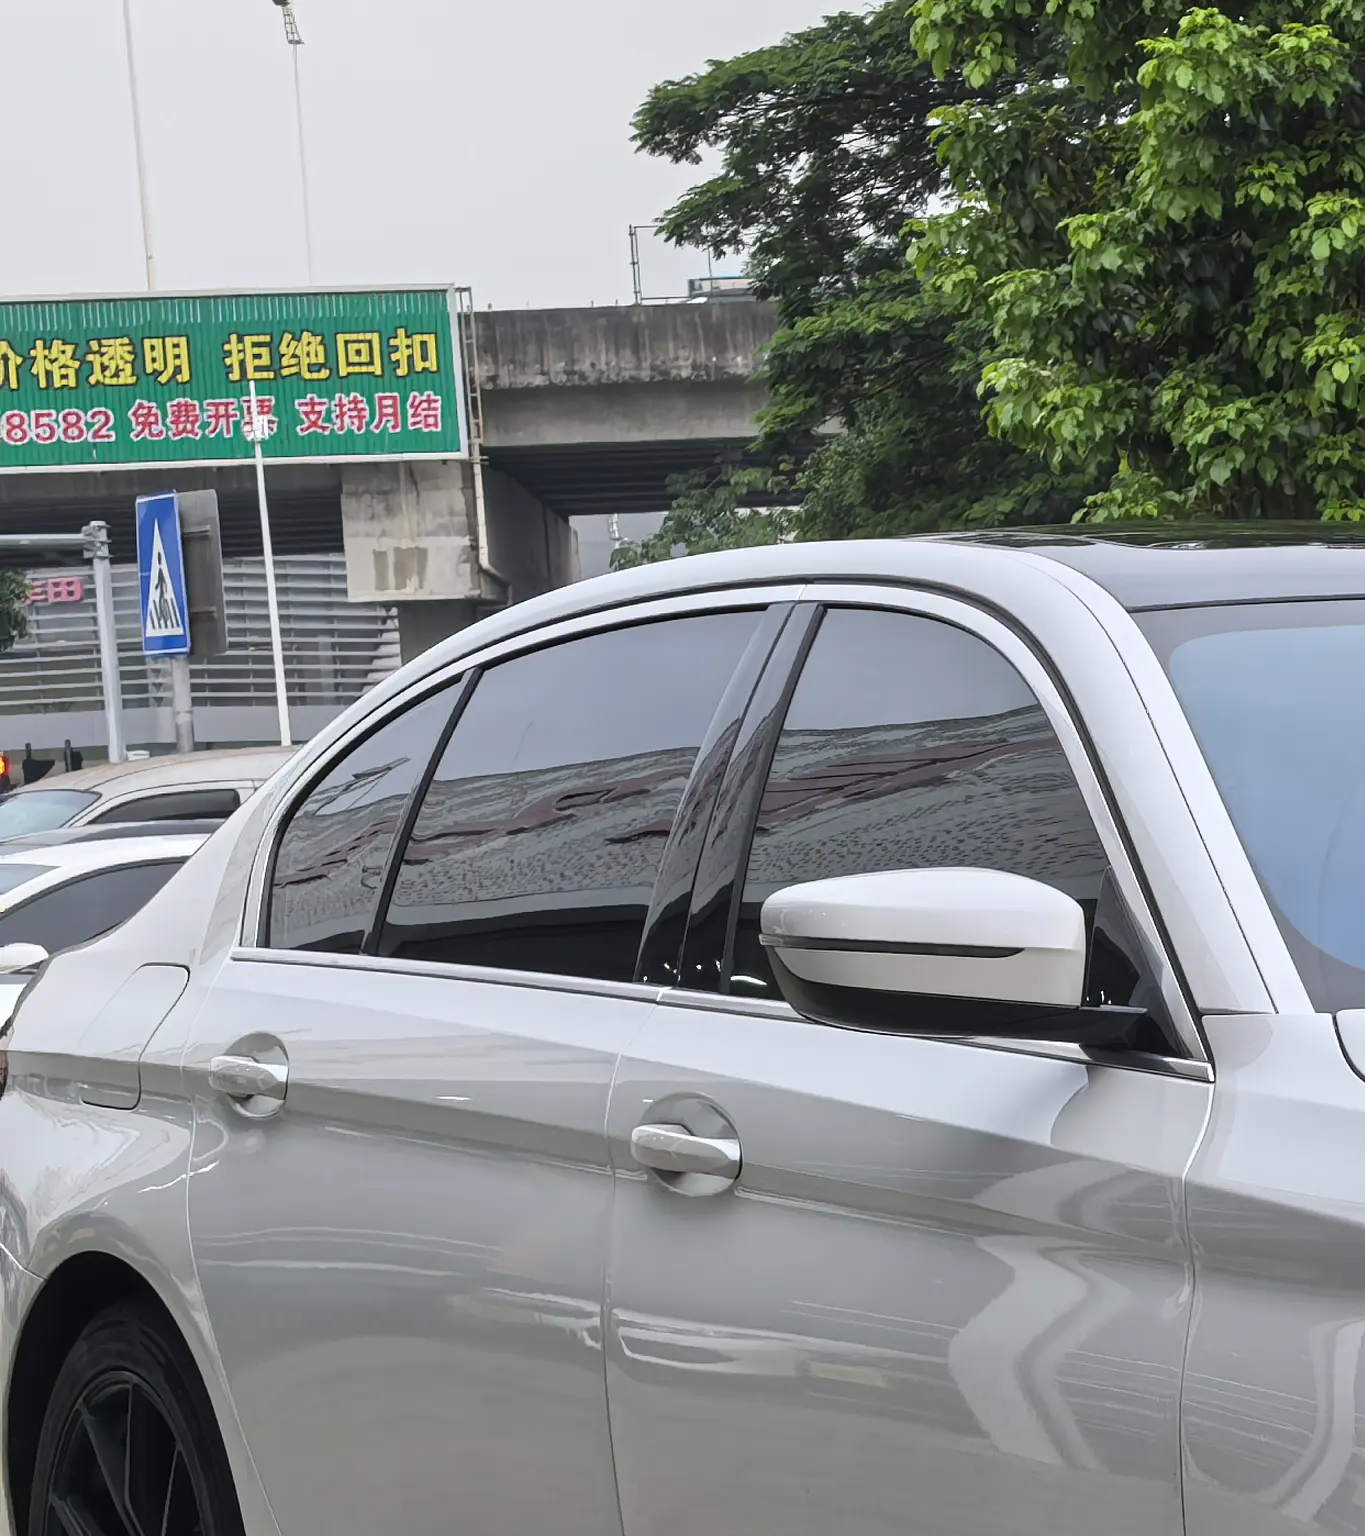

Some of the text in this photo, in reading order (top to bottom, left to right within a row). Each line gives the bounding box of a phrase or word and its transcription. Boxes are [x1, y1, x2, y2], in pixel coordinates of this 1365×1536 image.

[223, 327, 438, 382] 拒绝回扣
[294, 391, 441, 434] 支持月结
